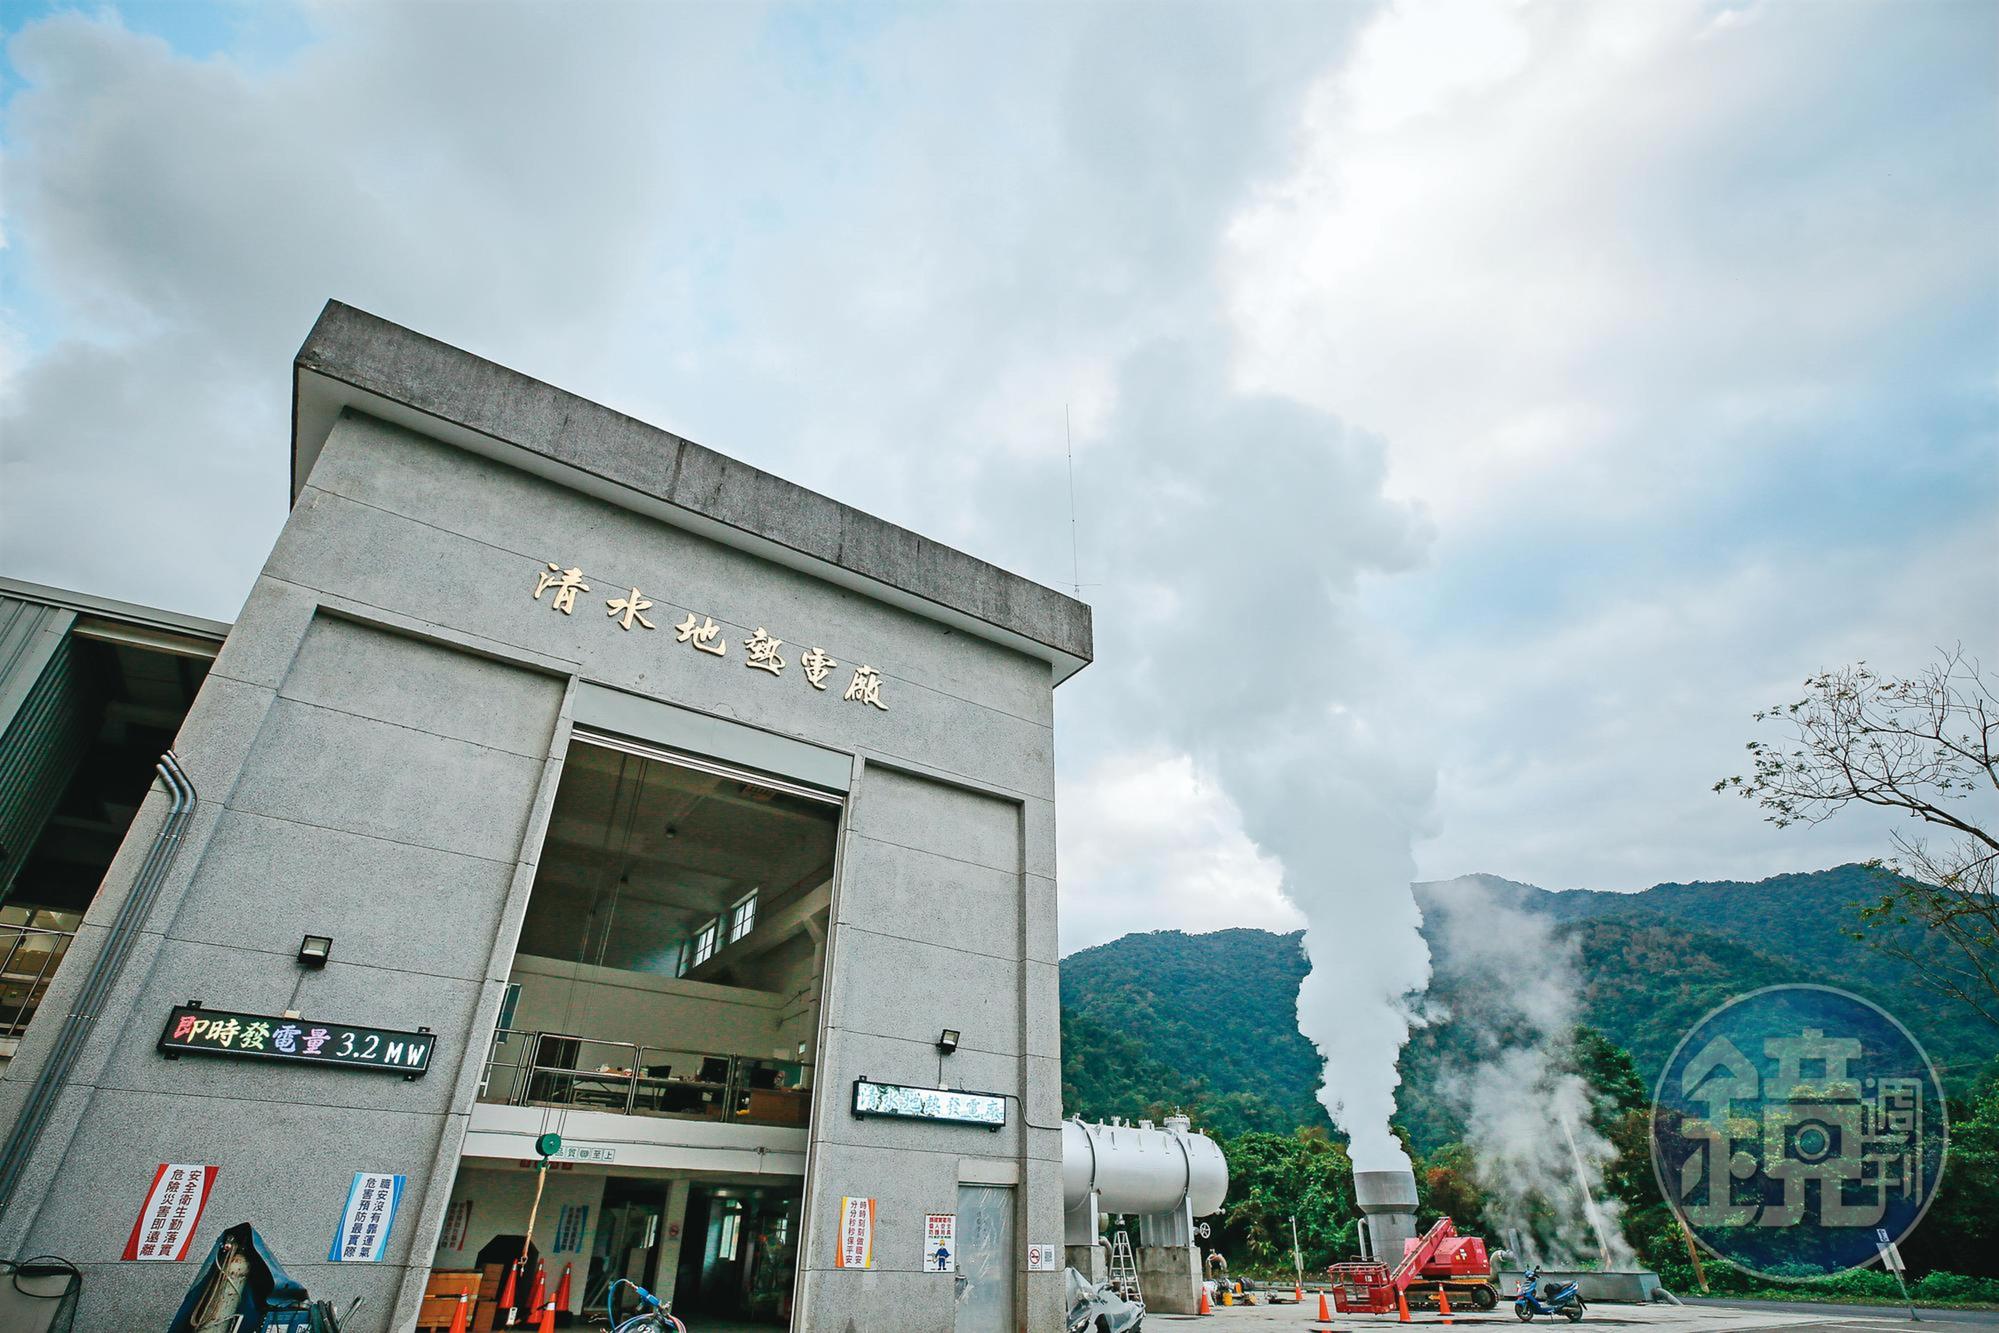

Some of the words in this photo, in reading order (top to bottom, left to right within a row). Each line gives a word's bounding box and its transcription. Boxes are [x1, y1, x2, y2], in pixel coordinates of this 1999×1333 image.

[533, 562, 890, 711] 清水地熱電廠
[173, 1015, 331, 1055] 即時發電量
[336, 1032, 379, 1060] 3.2
[384, 1041, 425, 1066] MW
